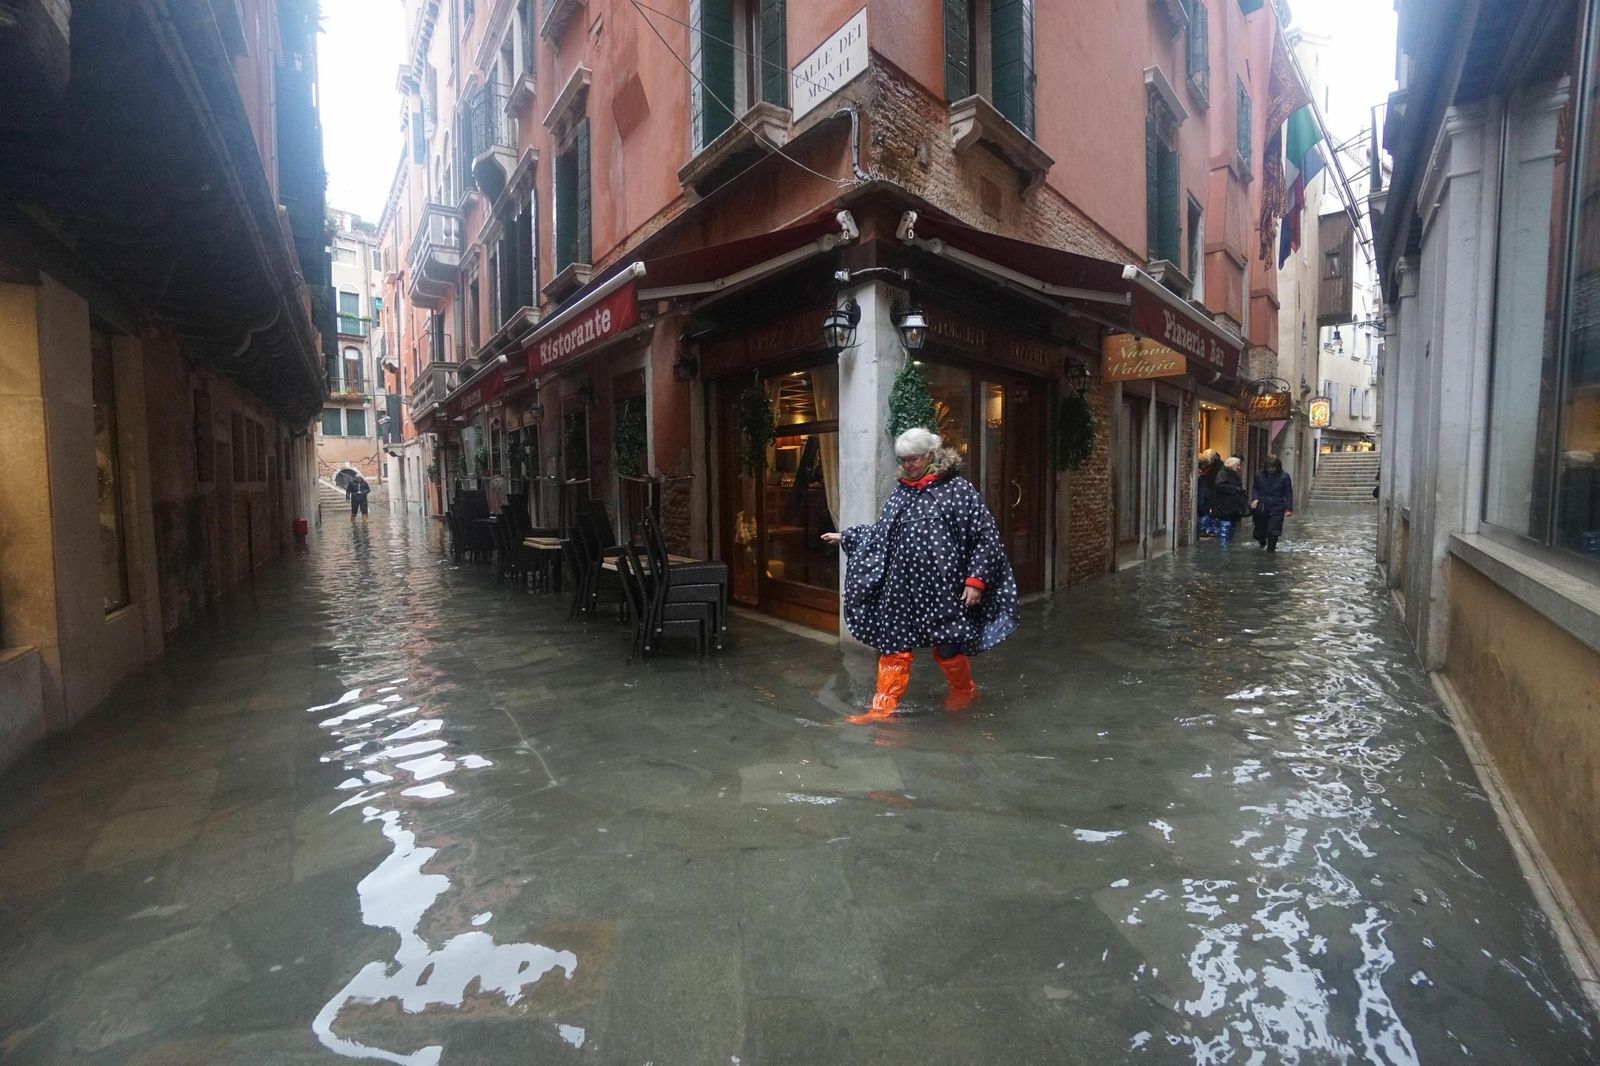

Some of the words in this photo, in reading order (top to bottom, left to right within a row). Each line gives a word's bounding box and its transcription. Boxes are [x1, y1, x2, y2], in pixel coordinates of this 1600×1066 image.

[795, 46, 833, 89] CALLE
[839, 23, 861, 54] DEI
[808, 57, 850, 102] MONTI
[540, 308, 611, 365] Ristorante
[1163, 309, 1206, 359] Pizzeria
[1210, 339, 1224, 367] Bar
[1108, 359, 1176, 378] Valigia
[1248, 393, 1286, 409] Hotel
